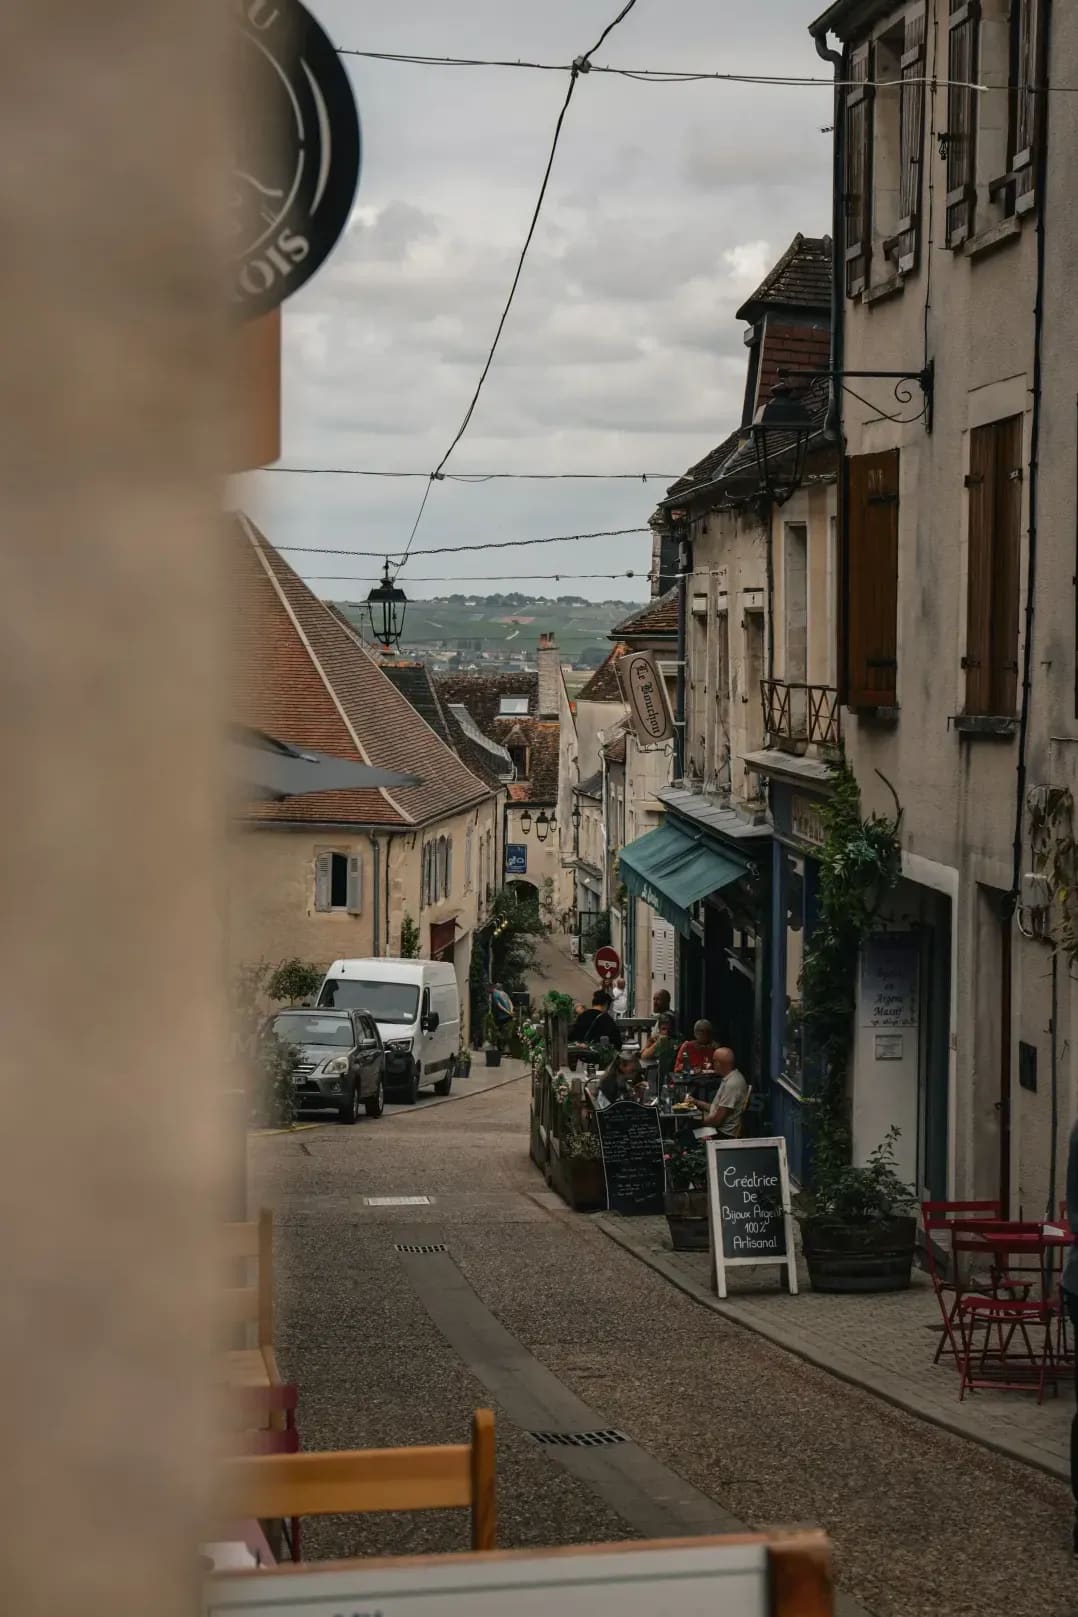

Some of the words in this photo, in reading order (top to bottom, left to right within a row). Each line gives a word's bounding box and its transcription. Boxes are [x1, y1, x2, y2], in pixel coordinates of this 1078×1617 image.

[640, 682, 660, 734] Bouchon
[723, 1166, 778, 1187] Créatrice
[743, 1191, 758, 1203] De
[722, 1206, 751, 1224] Bijoux
[733, 1235, 776, 1249] Artisanal
